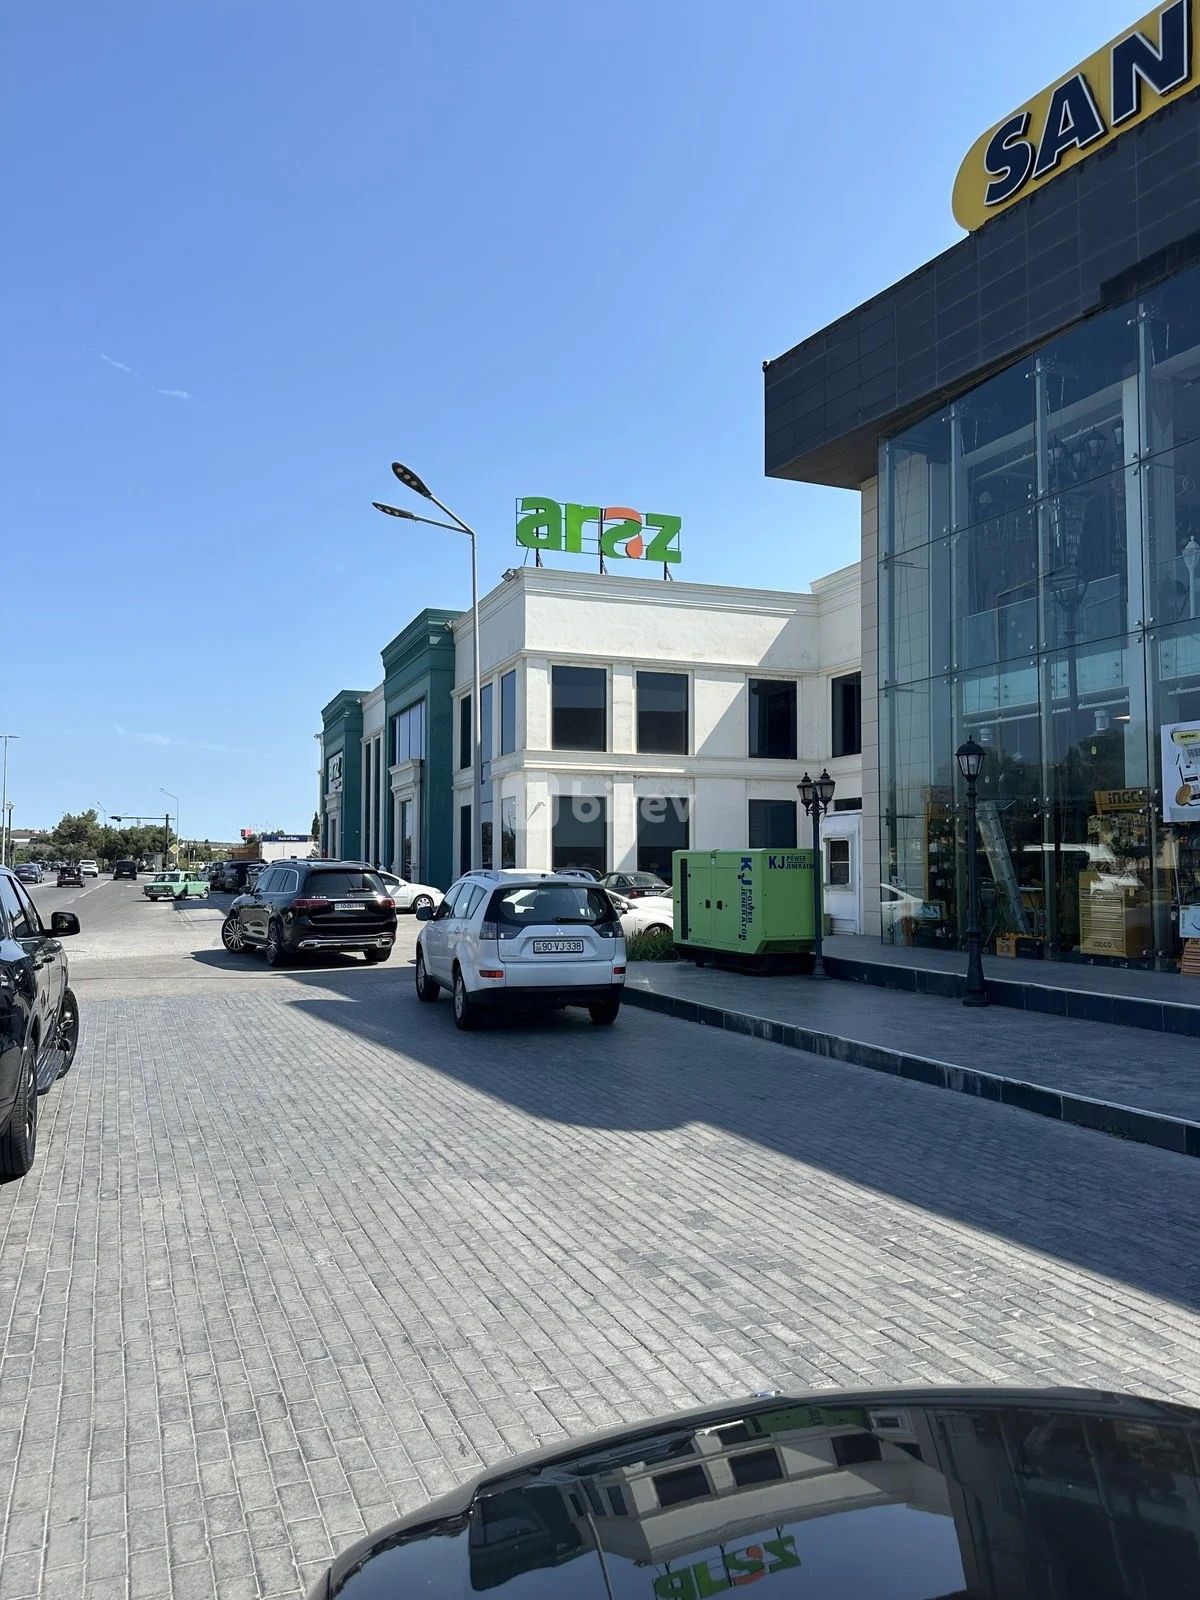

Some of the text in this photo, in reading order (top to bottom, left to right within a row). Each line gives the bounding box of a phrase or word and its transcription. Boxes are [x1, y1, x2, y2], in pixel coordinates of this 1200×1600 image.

[983, 0, 1192, 207] SAN
[516, 496, 682, 564] araz
[740, 857, 753, 886] KJ
[768, 855, 785, 870] KJ
[541, 941, 582, 952] 90-VJ-338
